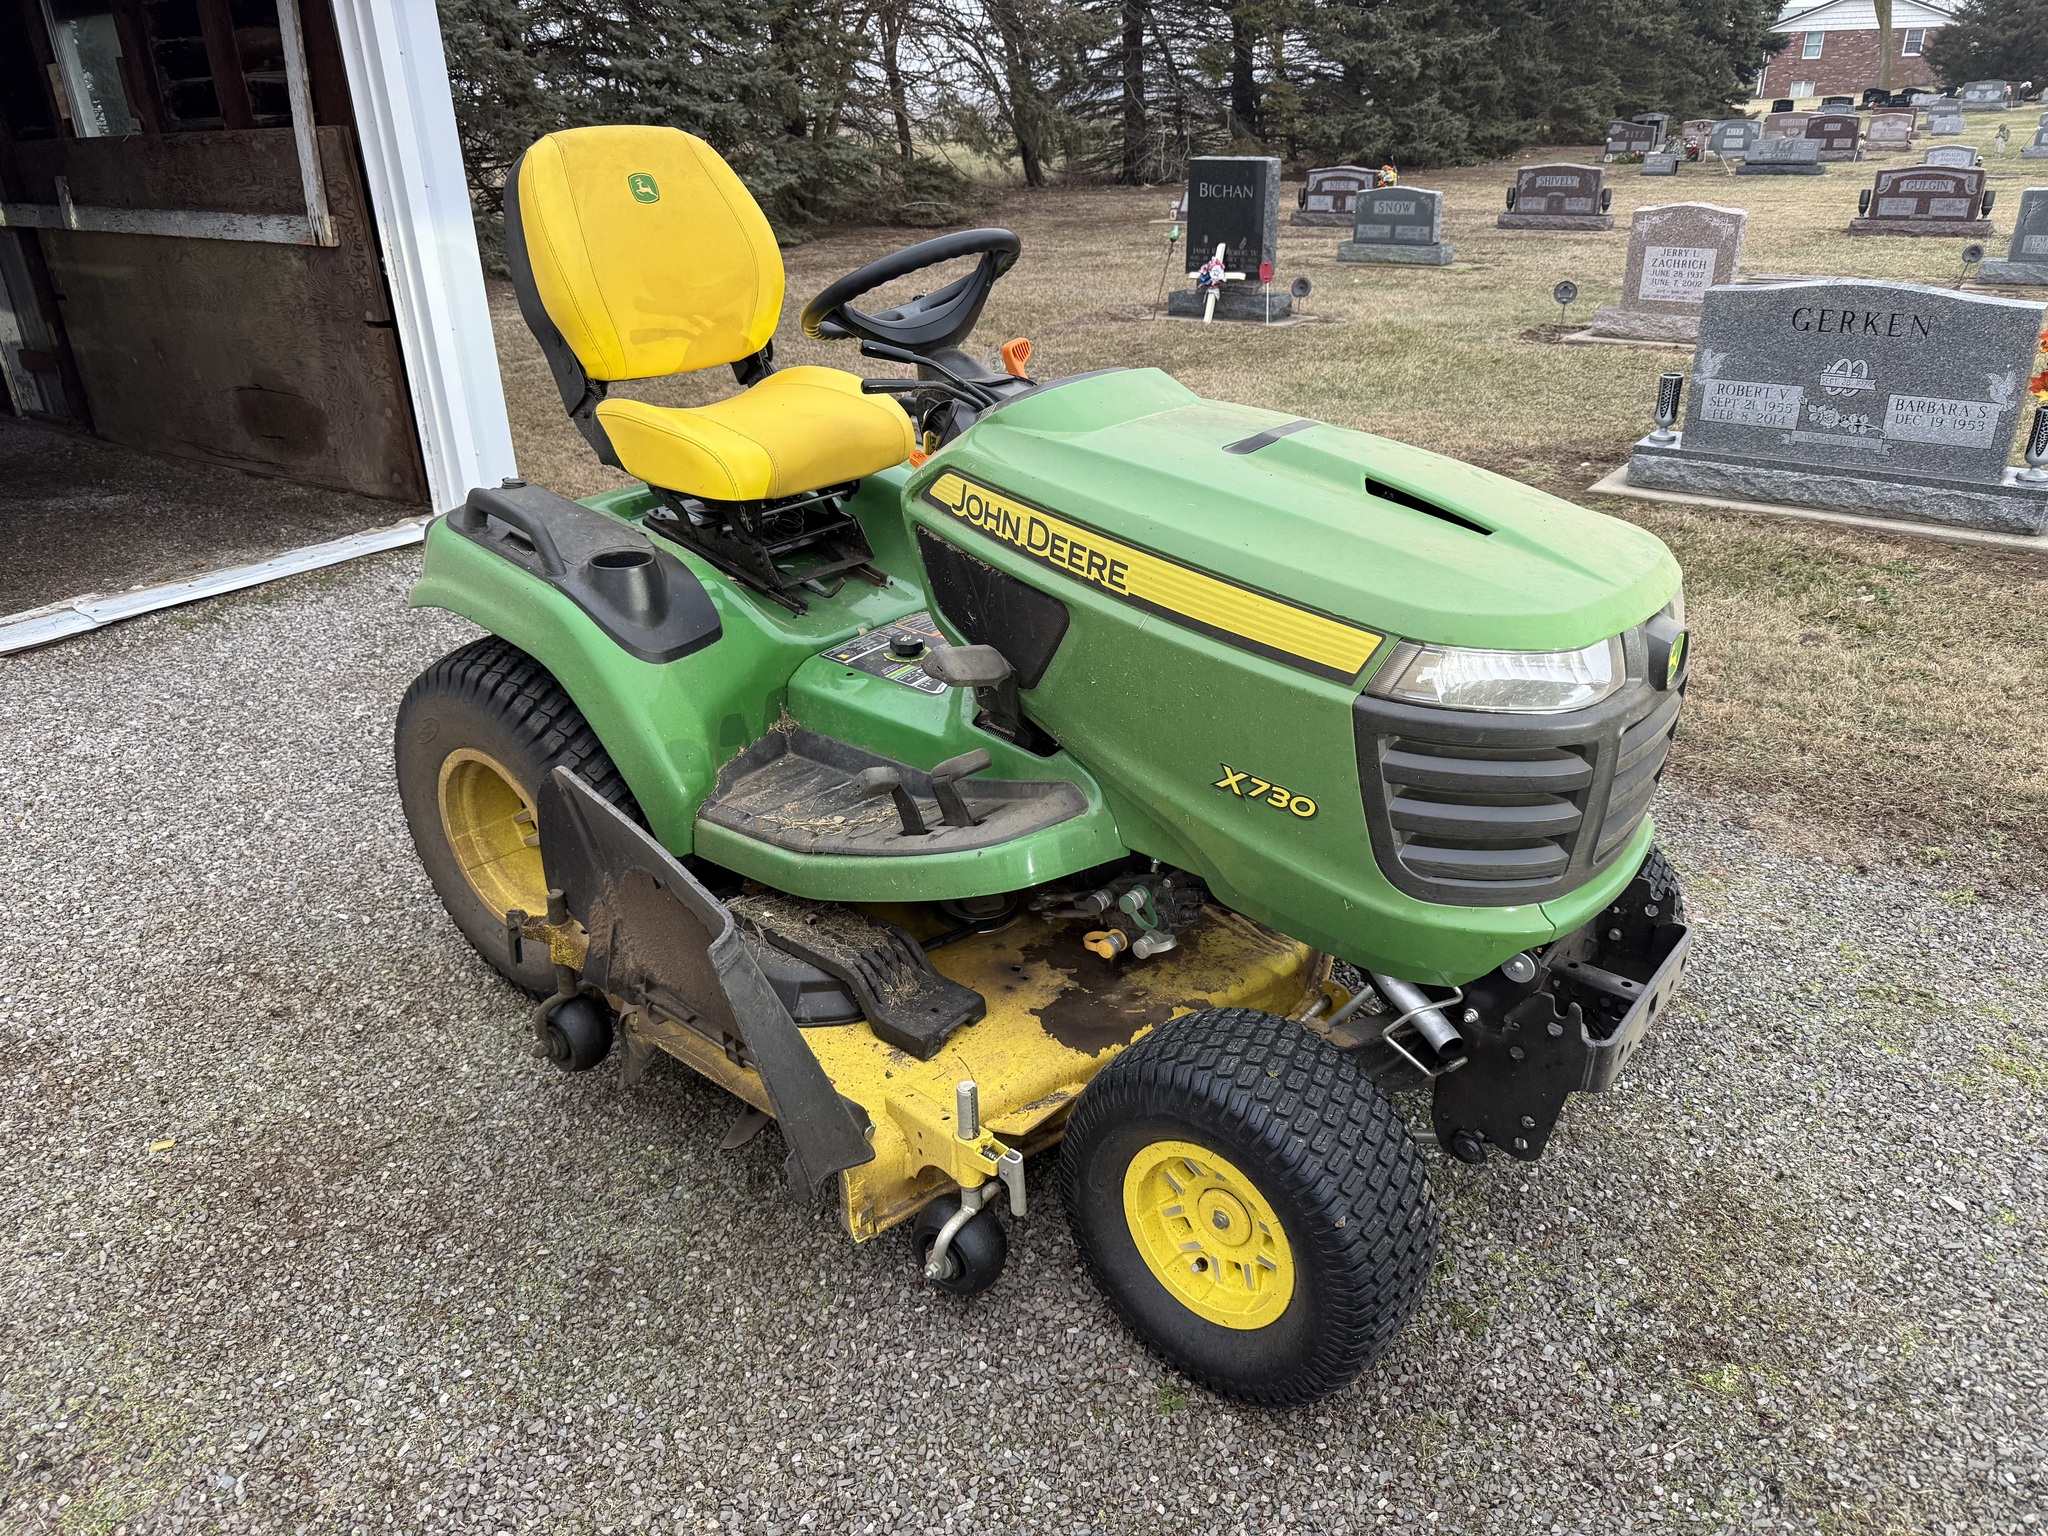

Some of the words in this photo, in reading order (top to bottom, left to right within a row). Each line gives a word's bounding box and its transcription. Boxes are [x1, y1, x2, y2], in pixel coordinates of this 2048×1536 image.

[1329, 180, 1351, 190] NIESE
[1540, 176, 1576, 186] SHIVELY
[1905, 180, 1949, 191] GULGIN
[1199, 182, 1254, 198] BICHAN
[1379, 201, 1412, 213] SNOW
[1660, 248, 1690, 257] JERRY
[1651, 258, 1707, 270] ZACHRICH
[1650, 269, 1670, 277] JUNE
[1686, 271, 1705, 279] 1937
[1650, 278, 1670, 287] JUNE
[1791, 307, 1934, 339] GERKEN
[1716, 383, 1773, 399] ROBERT
[1763, 401, 1793, 414] 1955
[1895, 398, 1969, 417] BARBARA
[1756, 413, 1786, 426] 2014
[1895, 413, 1924, 426] DEC.
[1952, 418, 1985, 432] 1953
[951, 483, 1021, 543] JOHN
[1025, 516, 1130, 592] DEERE
[1212, 762, 1318, 819] X730
